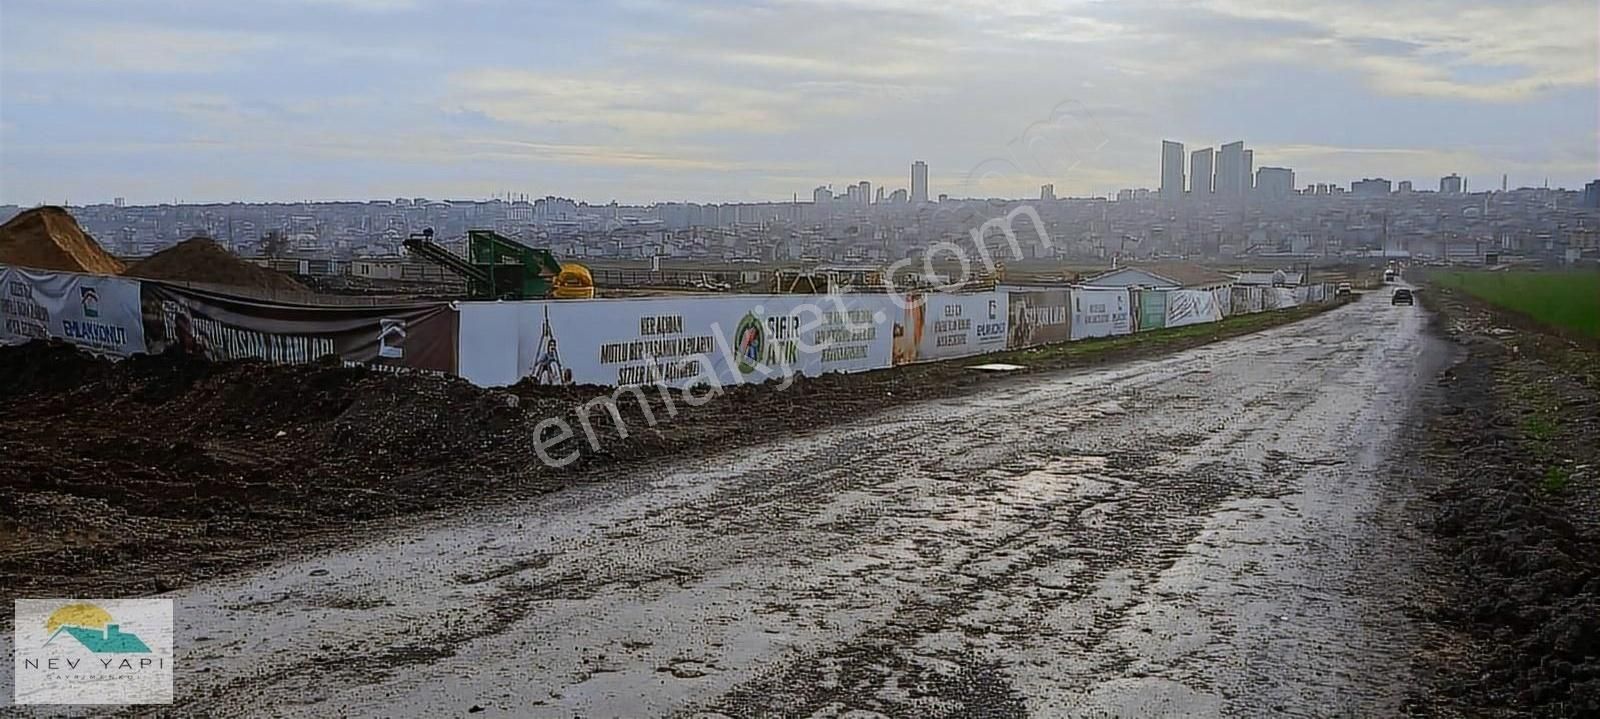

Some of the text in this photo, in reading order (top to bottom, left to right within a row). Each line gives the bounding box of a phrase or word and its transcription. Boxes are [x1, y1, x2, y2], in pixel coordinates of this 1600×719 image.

[767, 315, 801, 339] SIFIR
[601, 343, 628, 364] MUTLU
[766, 340, 798, 366] ATIK
